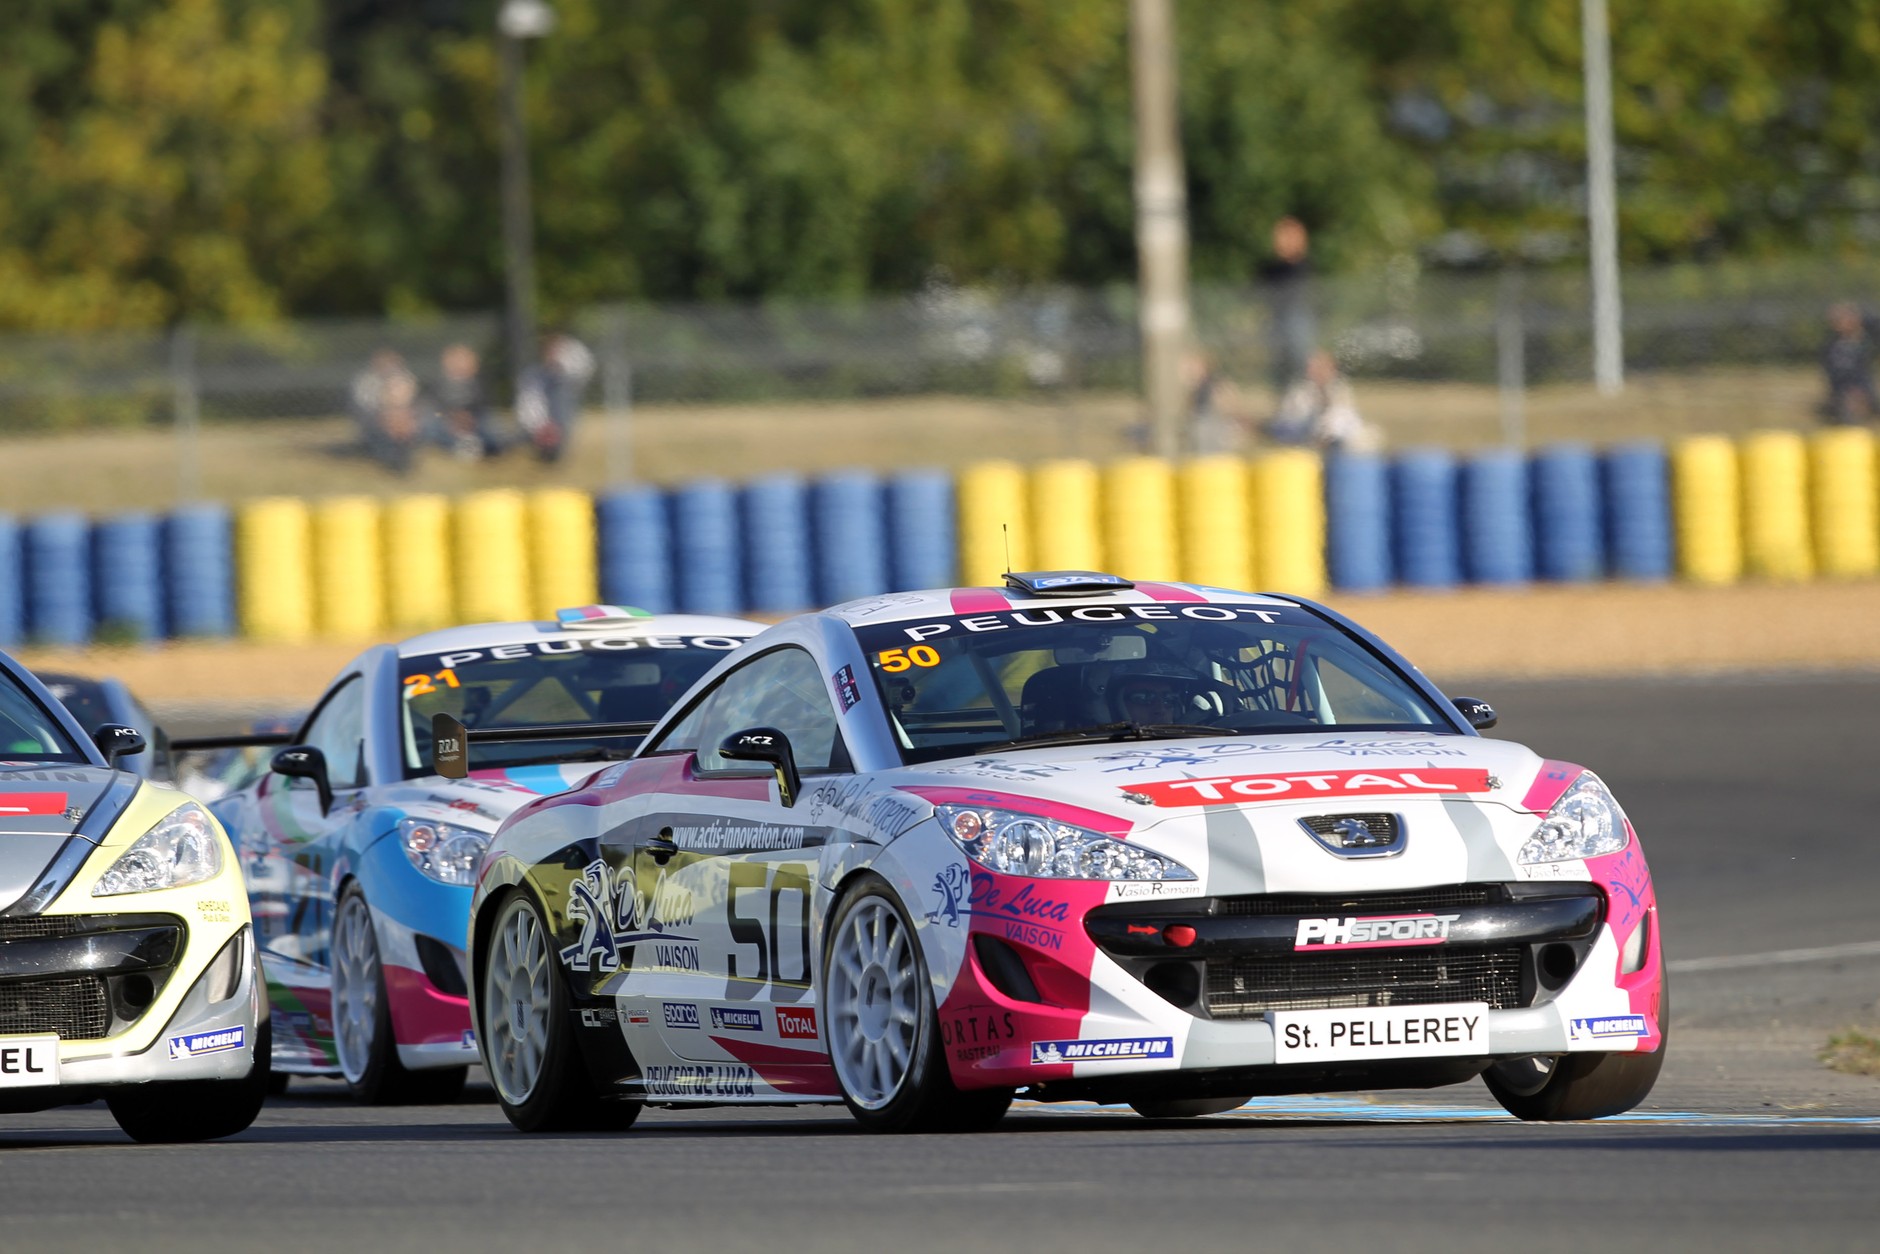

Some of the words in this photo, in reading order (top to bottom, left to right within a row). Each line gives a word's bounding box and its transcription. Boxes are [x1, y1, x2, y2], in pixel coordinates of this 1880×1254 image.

[903, 605, 1282, 642] PEUGEOT
[440, 635, 751, 668] PEUGEO
[878, 644, 942, 674] 50
[403, 668, 461, 697] 21
[738, 735, 774, 746] RCZ
[1303, 739, 1447, 750] Luca
[1329, 749, 1468, 757] VAISON
[1169, 773, 1458, 800] TOTAL
[672, 819, 805, 849] www.actis-innovation.com
[647, 867, 696, 933] Luca
[967, 872, 1001, 908] De
[1001, 883, 1070, 922] Luca
[1114, 884, 1150, 897] Vasio
[1151, 882, 1200, 895] Romain
[724, 861, 814, 1000] 50
[1005, 922, 1063, 950] VAISON
[656, 945, 699, 972] VAISON
[724, 1012, 760, 1025] MICHELIN
[778, 1013, 816, 1034] TOTAL
[942, 1012, 1015, 1046] ORTAS
[1593, 1019, 1644, 1033] MICHELIN
[191, 1030, 243, 1050] MICHELIN
[1285, 1022, 1319, 1049] St.
[1331, 1016, 1479, 1047] PELLEREY
[1, 1047, 44, 1074] EL
[1066, 1040, 1167, 1057] MICHELIN
[642, 1065, 693, 1096] PEUGEOT
[695, 1065, 714, 1096] DE
[717, 1066, 755, 1097] LUCA
